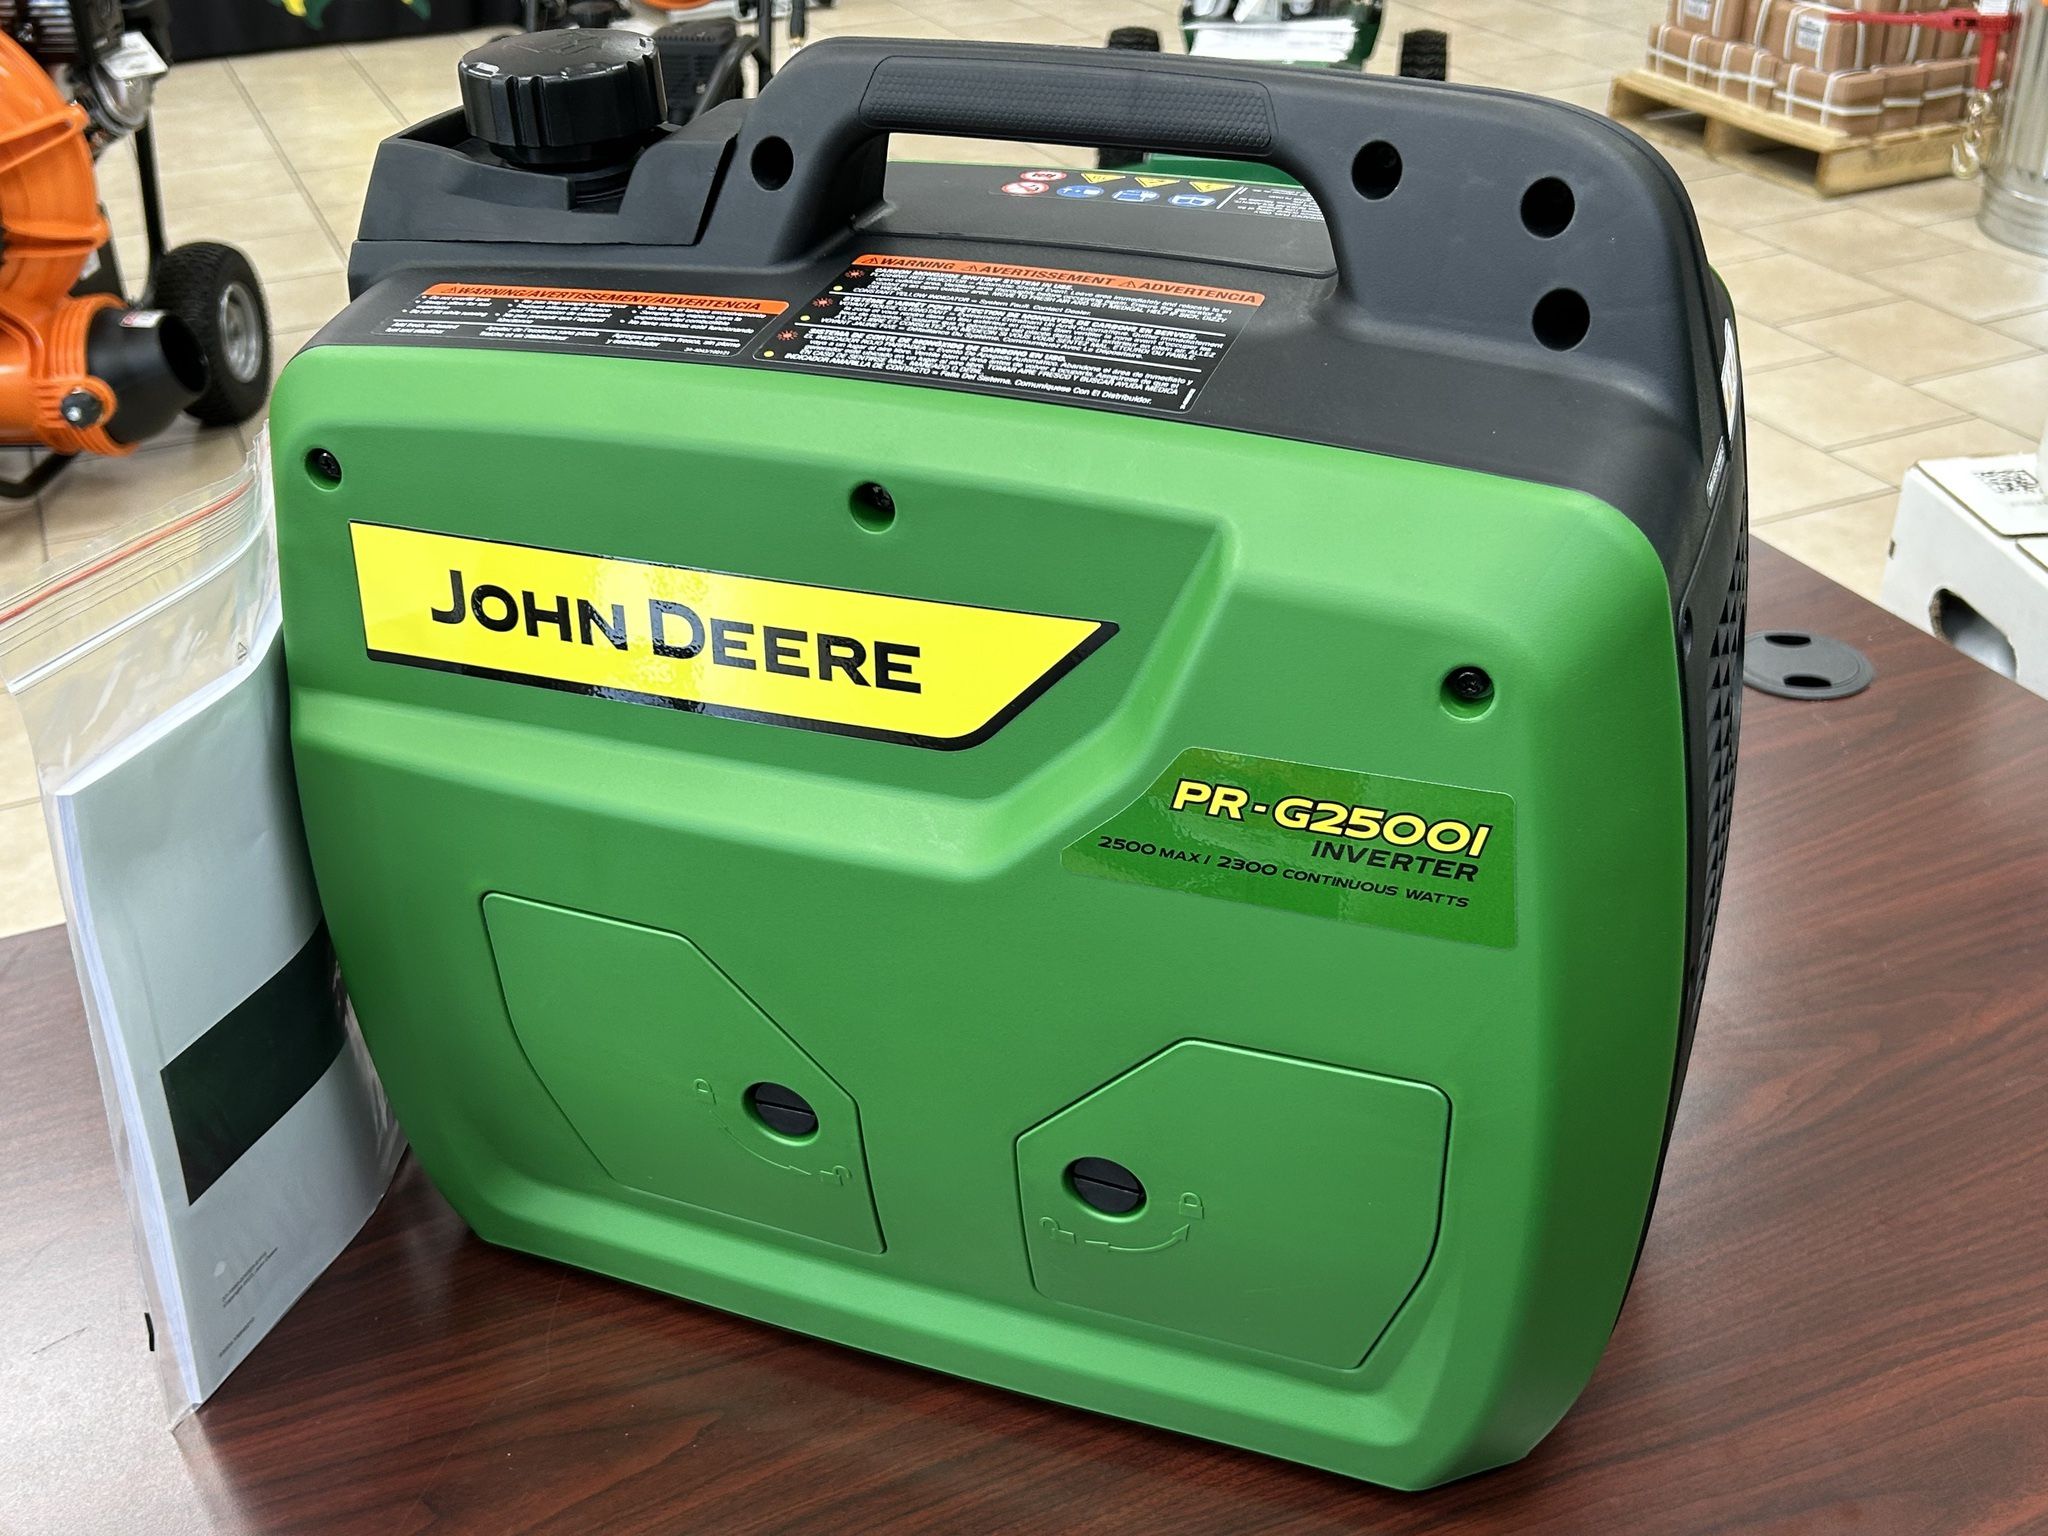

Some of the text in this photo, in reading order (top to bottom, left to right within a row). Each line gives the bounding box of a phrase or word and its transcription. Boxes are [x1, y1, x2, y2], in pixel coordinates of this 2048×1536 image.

[880, 258, 955, 269] WARNING
[979, 266, 1114, 284] AVERTISSEMENT
[1138, 282, 1256, 302] ADVERTENCIA
[431, 569, 922, 694] JOHN DEERE
[1098, 836, 1156, 856] 2500
[1216, 855, 1278, 876] 2300
[1282, 868, 1398, 897] CONTINUOUS
[1405, 887, 1469, 908] WATTS
[1311, 840, 1479, 882] INVERTER
